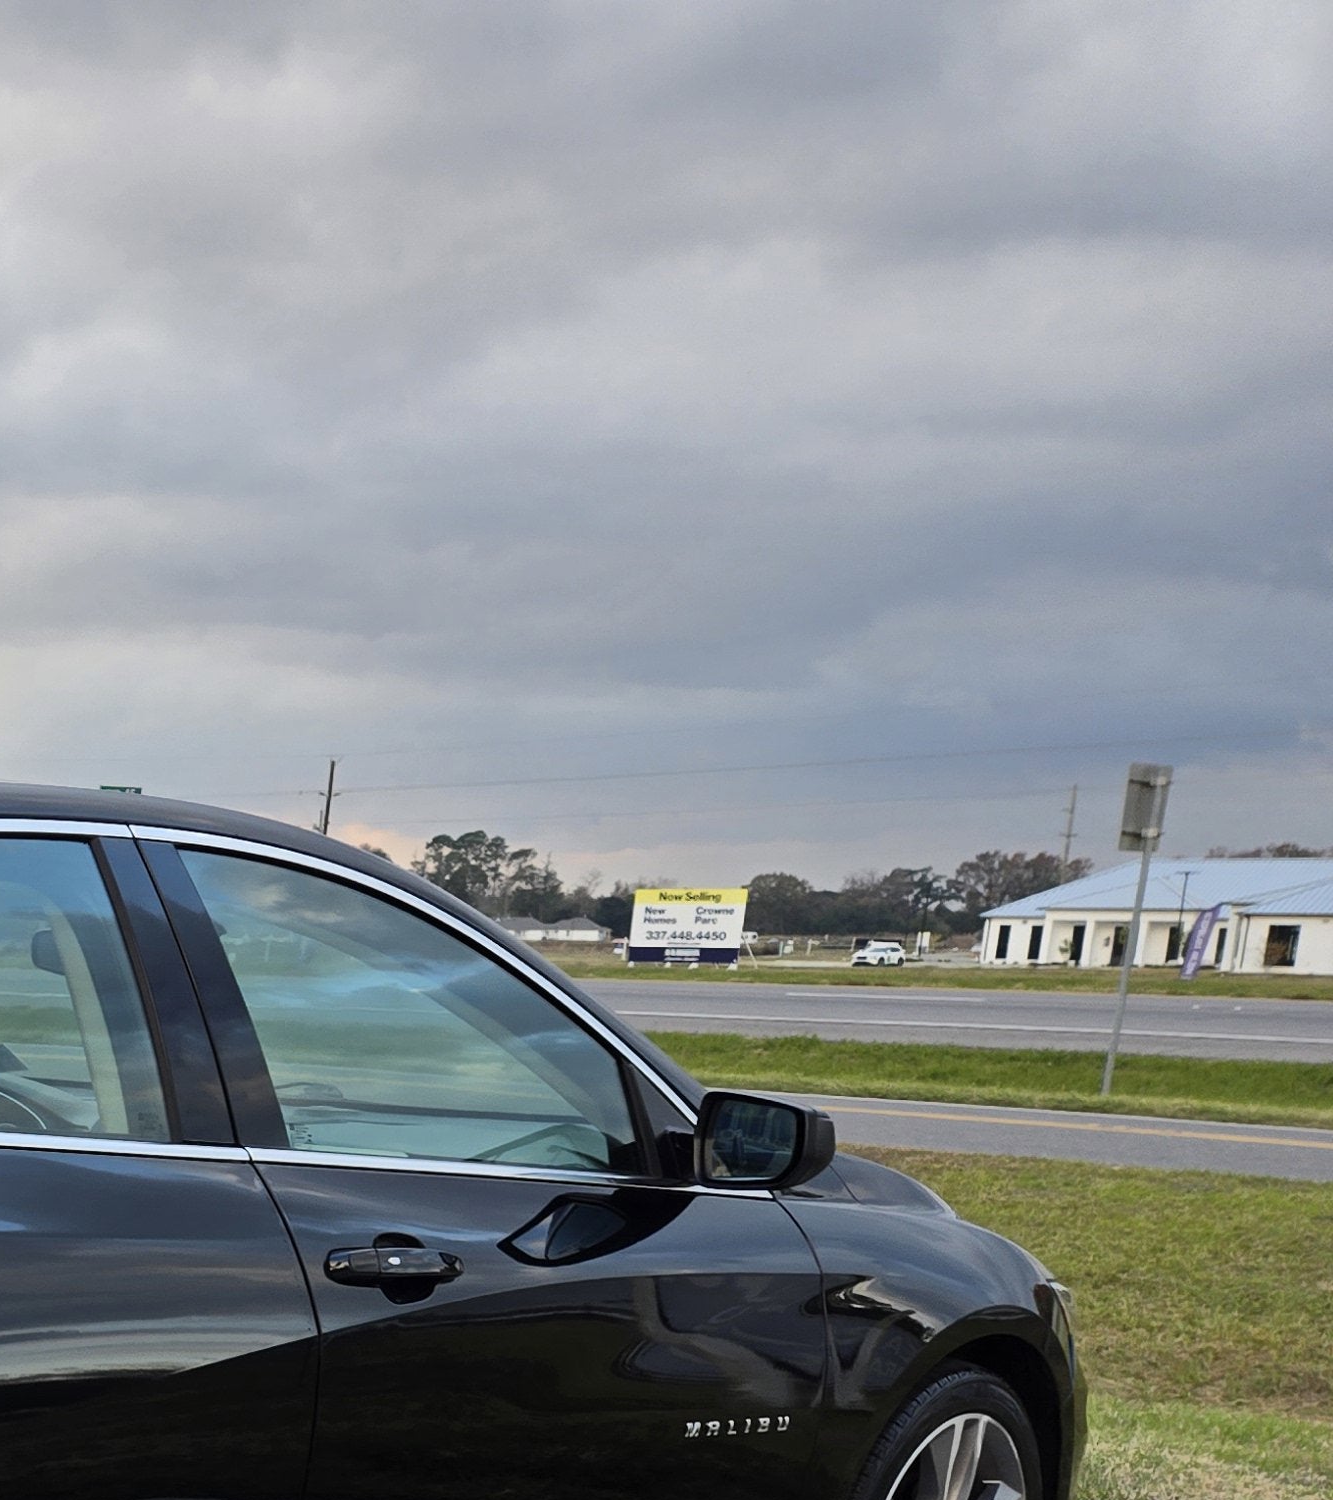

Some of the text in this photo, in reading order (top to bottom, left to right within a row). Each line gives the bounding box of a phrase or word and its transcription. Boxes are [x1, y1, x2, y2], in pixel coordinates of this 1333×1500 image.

[659, 892, 722, 904] Now Selling
[645, 906, 666, 915] New
[696, 906, 735, 915] Crowne
[643, 916, 677, 924] Homes
[684, 1415, 790, 1438] MALIBU
